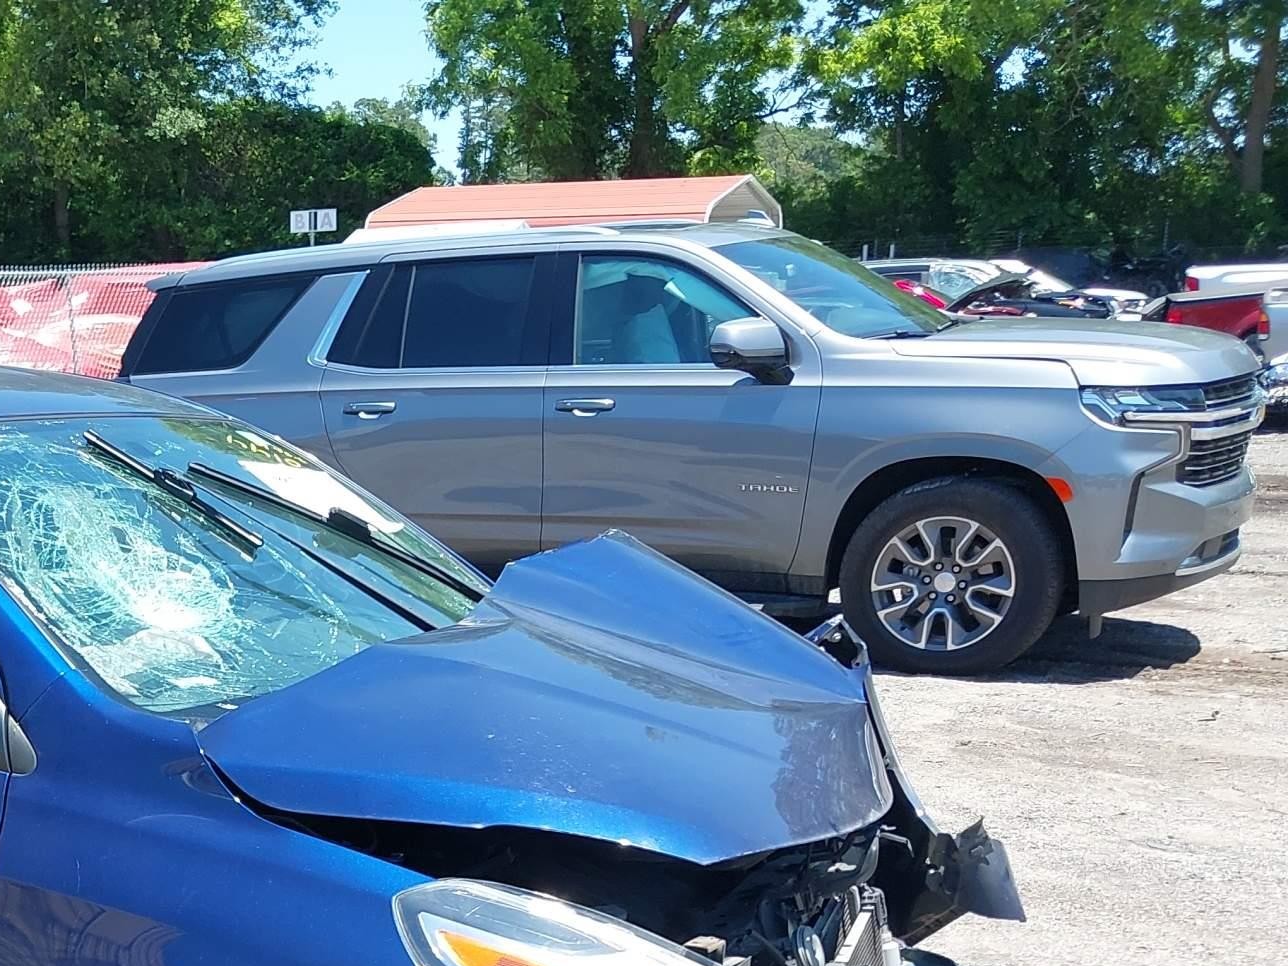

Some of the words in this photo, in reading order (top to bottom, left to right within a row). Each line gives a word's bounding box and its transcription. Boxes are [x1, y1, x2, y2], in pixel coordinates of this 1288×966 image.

[294, 213, 305, 229] B
[320, 211, 334, 229] A
[737, 483, 800, 493] TAHOE
